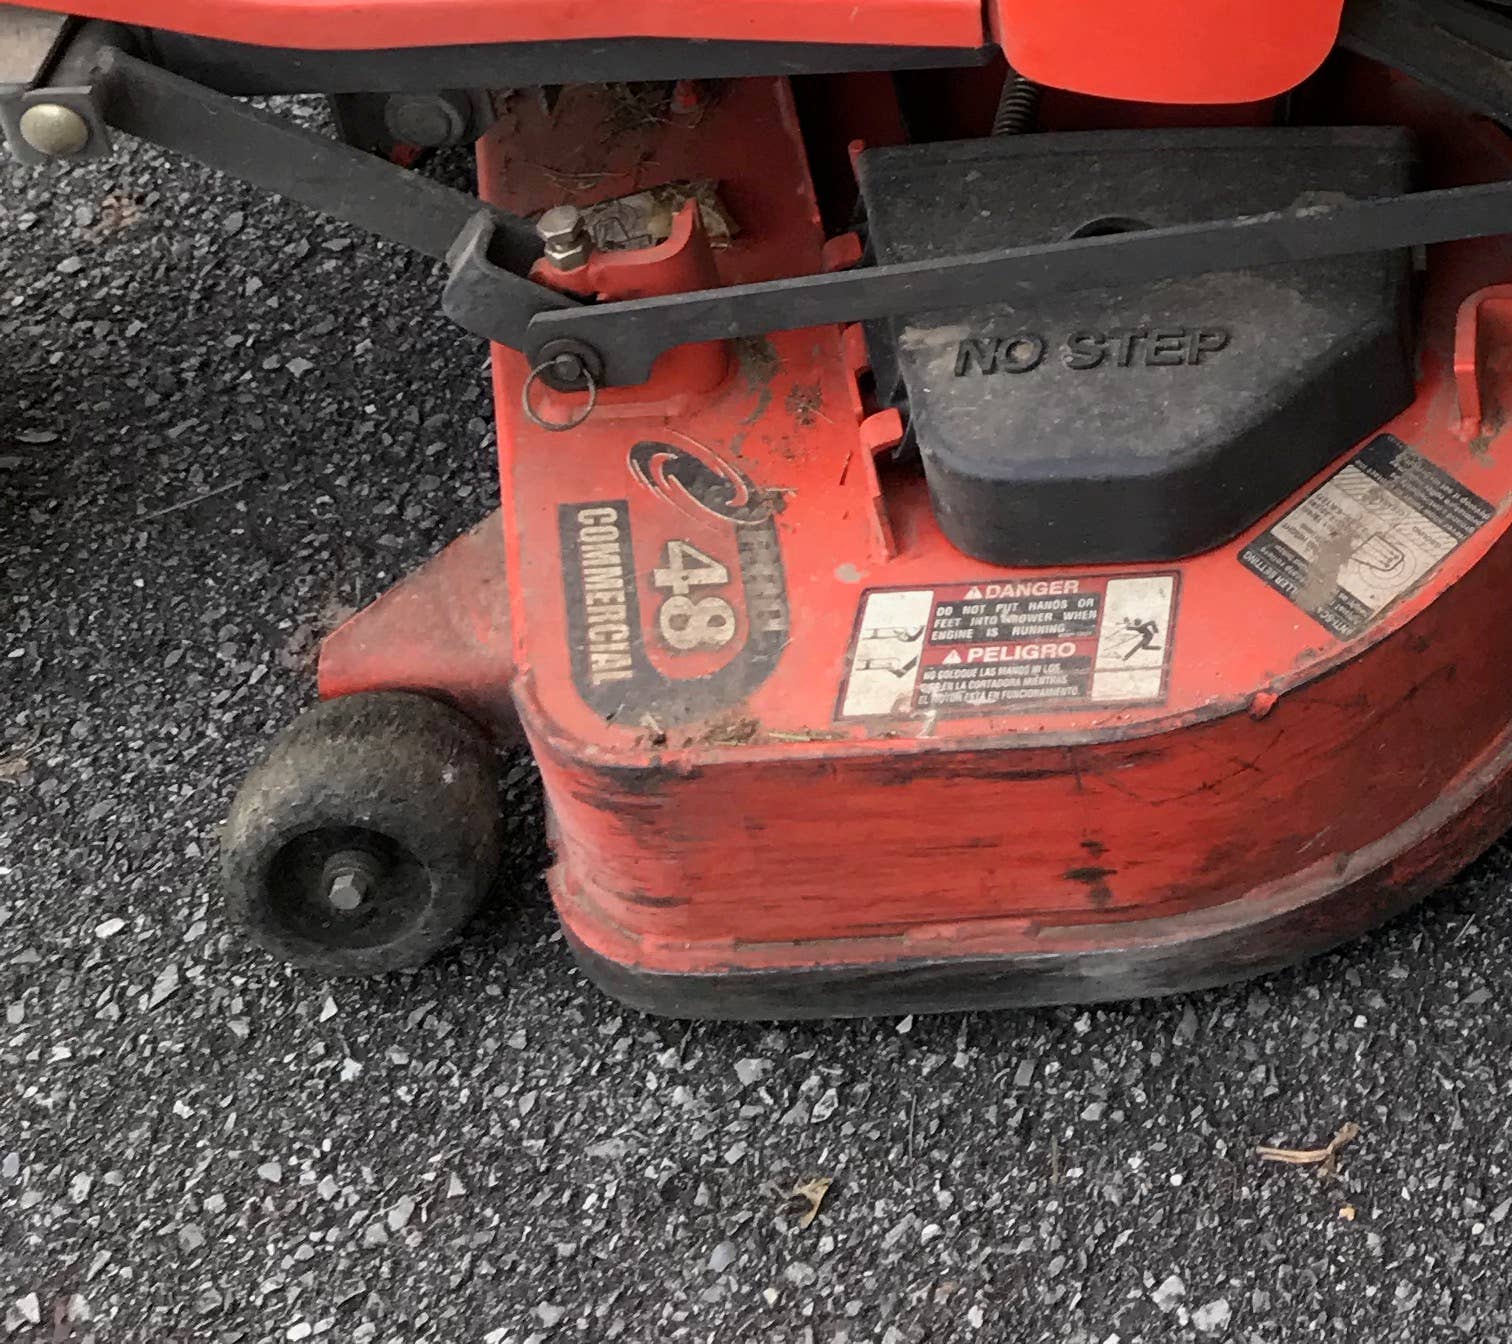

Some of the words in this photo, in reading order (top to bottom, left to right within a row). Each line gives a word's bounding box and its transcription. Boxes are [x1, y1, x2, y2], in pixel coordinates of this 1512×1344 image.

[954, 333, 1049, 377] NO
[1063, 326, 1232, 371] STEP
[577, 507, 634, 686] COMMERCIAL
[653, 540, 736, 649] 48
[984, 579, 1080, 600] DANGER
[936, 606, 953, 617] DO
[961, 604, 987, 615] NOT
[995, 601, 1019, 613] PUT
[1028, 599, 1069, 612] HANDS
[1077, 598, 1095, 608] OR
[933, 617, 962, 629] FEET
[969, 615, 998, 627] INTO
[1063, 609, 1097, 621] WHEN
[931, 628, 974, 641] ENGINE
[985, 627, 999, 638] IS
[966, 642, 1077, 663] PELIGRO
[979, 665, 997, 677] LAS
